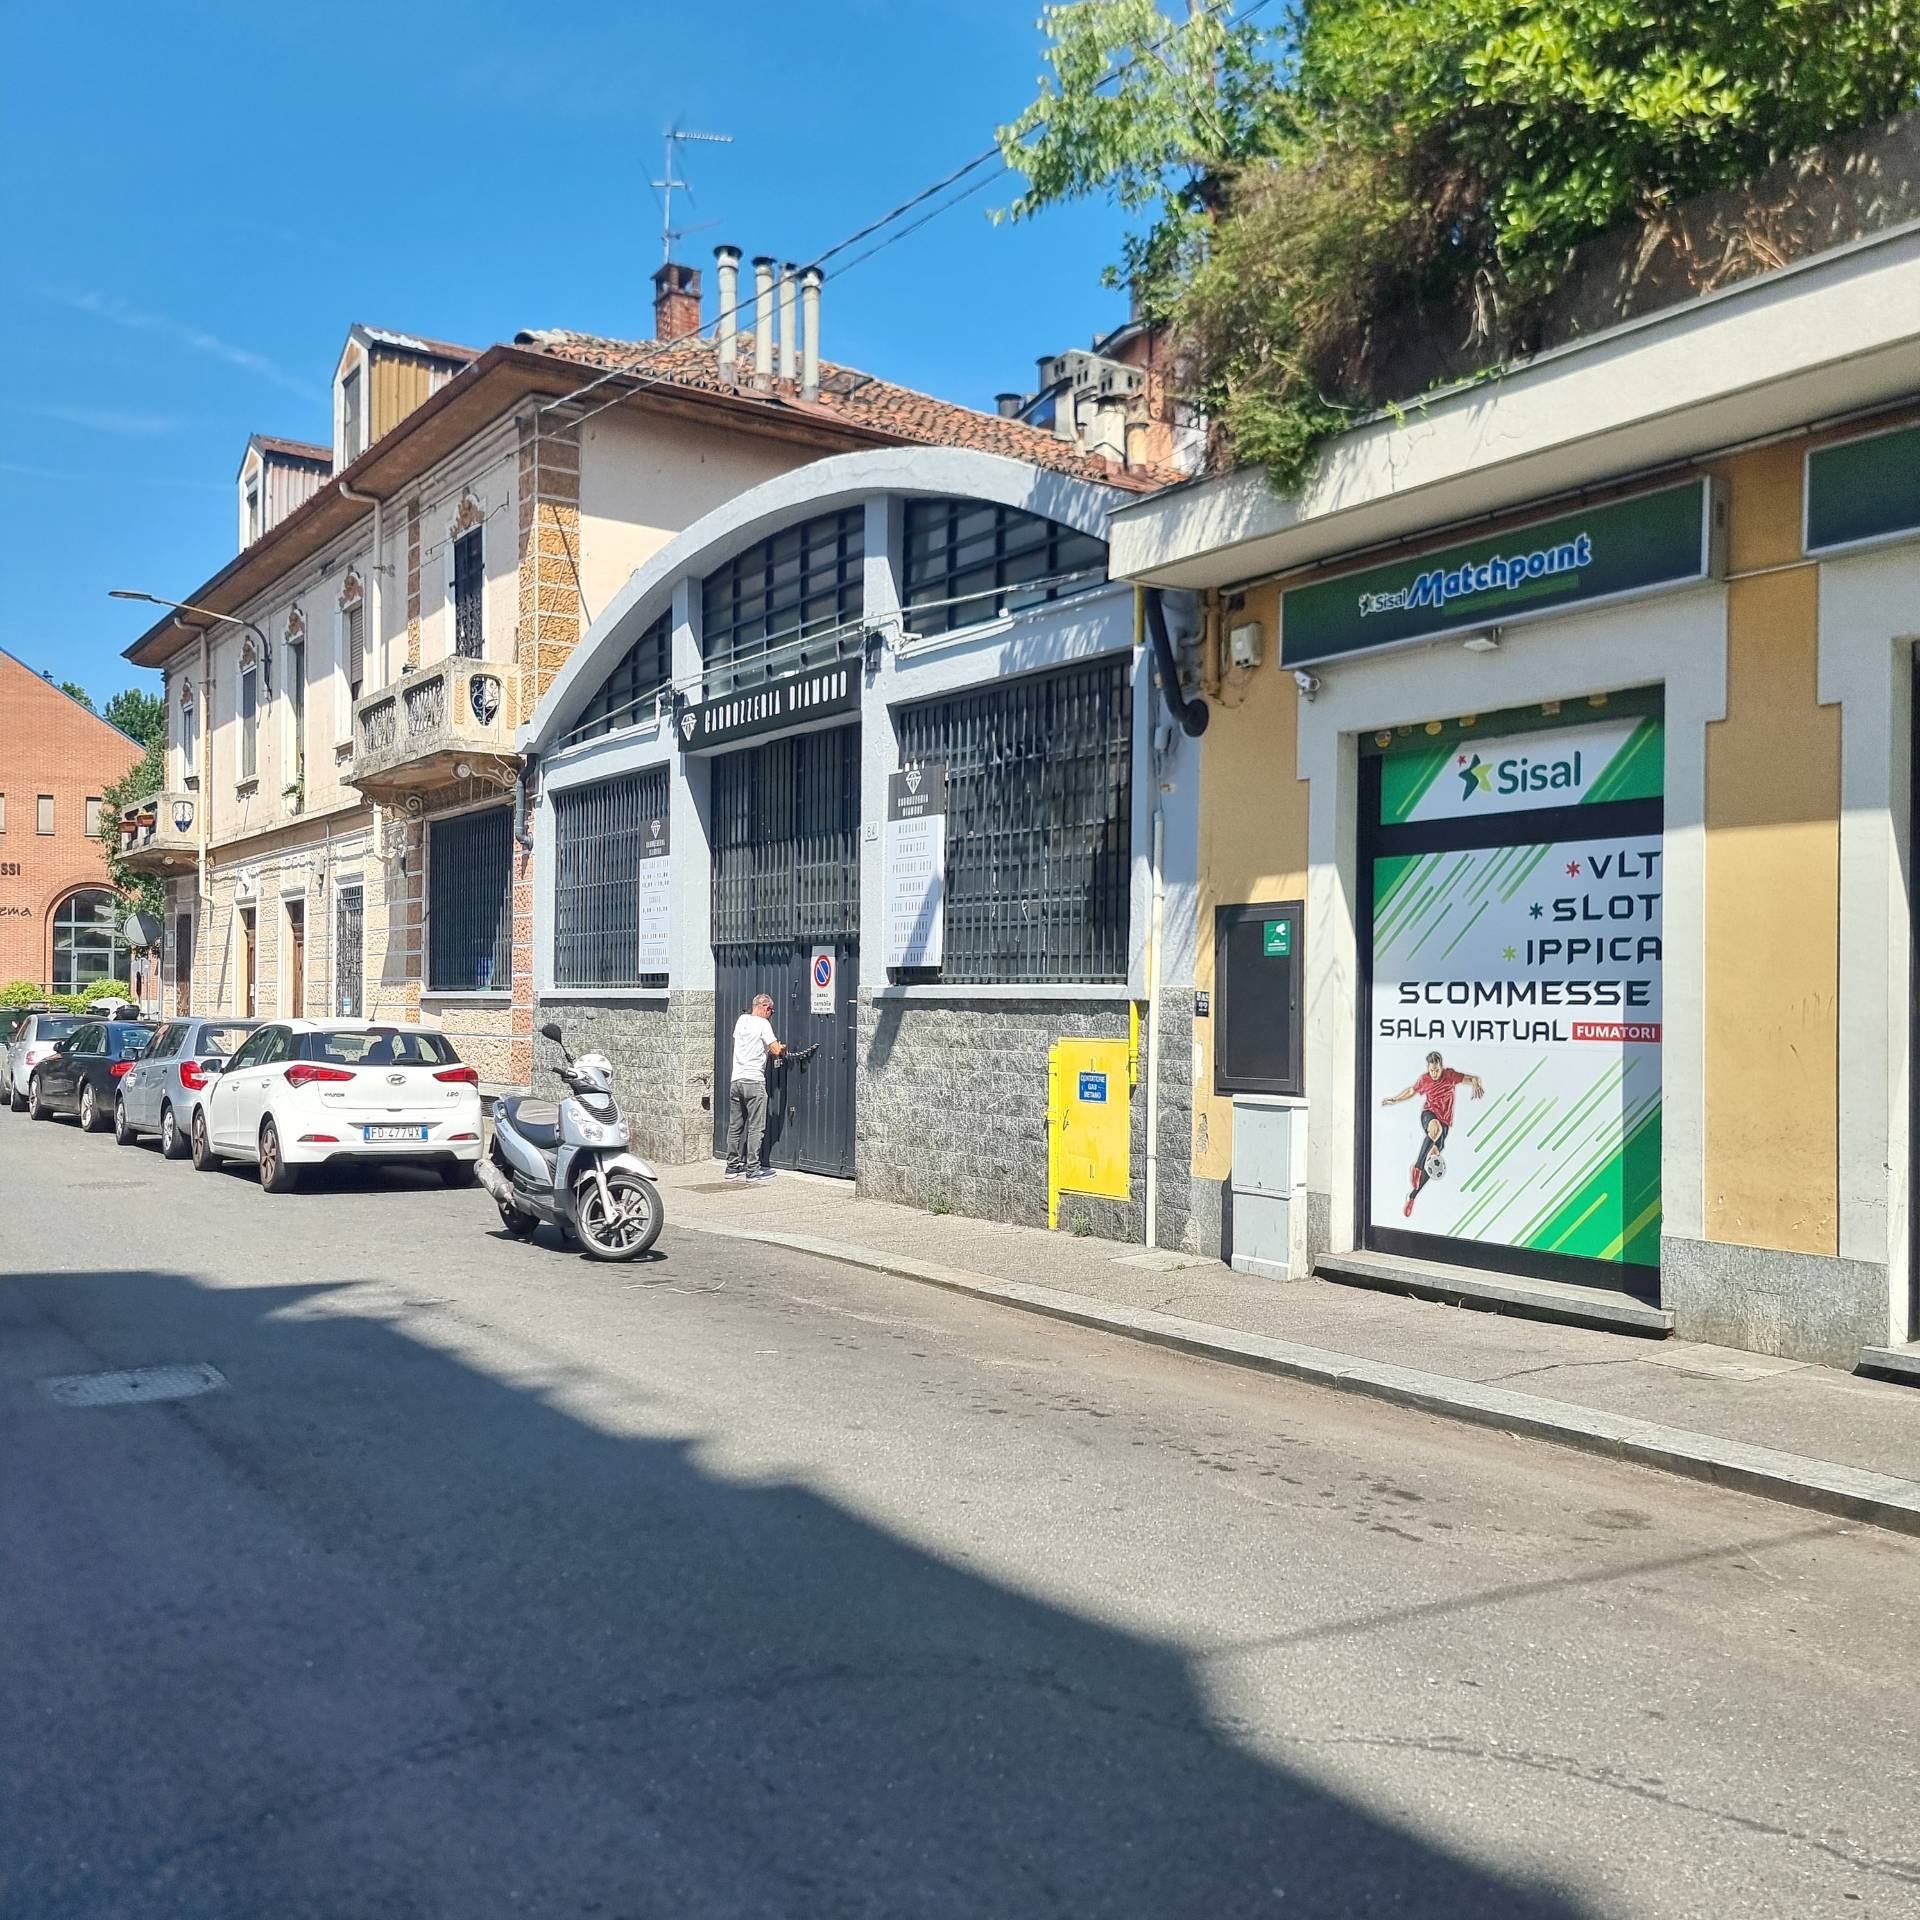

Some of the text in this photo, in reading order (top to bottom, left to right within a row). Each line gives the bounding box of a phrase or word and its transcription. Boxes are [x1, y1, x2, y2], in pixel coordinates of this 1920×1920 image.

[1375, 532, 1592, 612] Sisal Matchpoint
[704, 670, 847, 734] CARROZZERIA DIAMOND
[1497, 750, 1581, 795] Sisal
[1587, 850, 1662, 879] VLT
[1552, 893, 1662, 922] SLOT
[1526, 936, 1662, 966] IPPICA
[1398, 980, 1651, 1008] SCOMMESSE
[1379, 1016, 1656, 1043] SALA VIRTUAL FUMATORI
